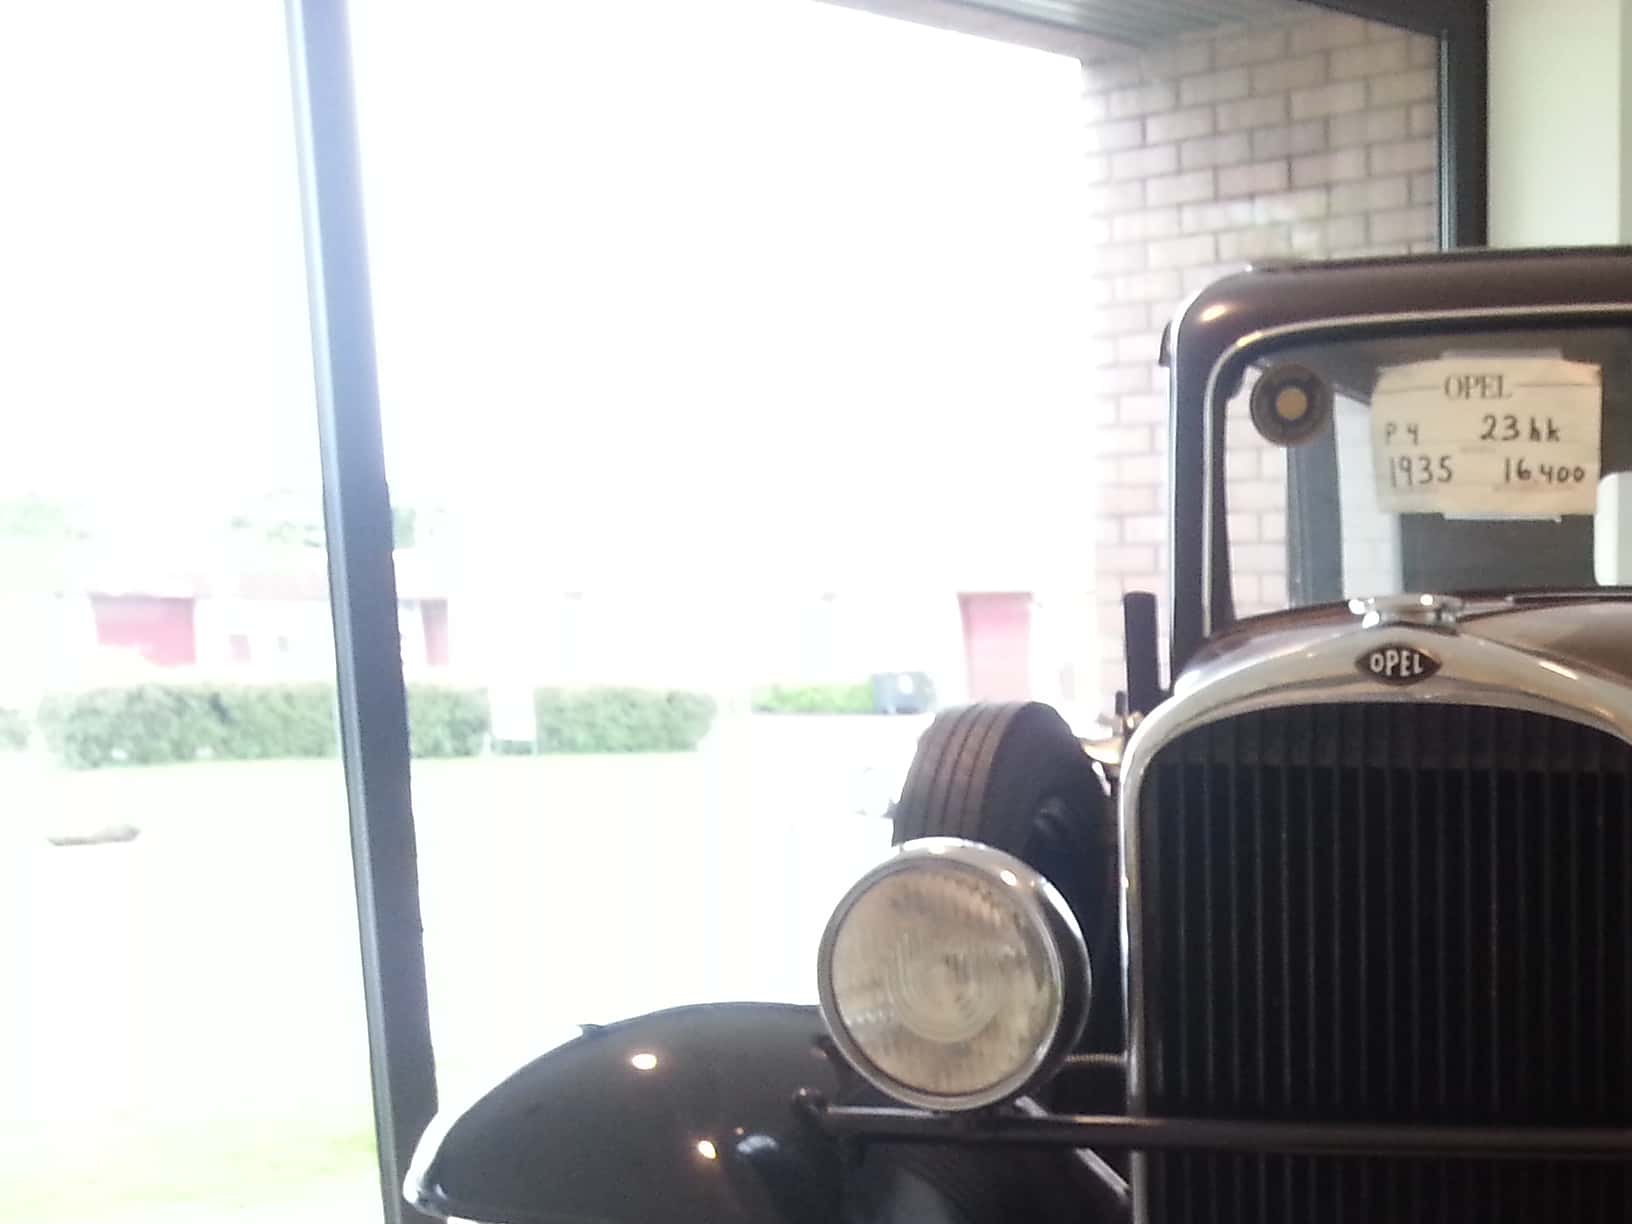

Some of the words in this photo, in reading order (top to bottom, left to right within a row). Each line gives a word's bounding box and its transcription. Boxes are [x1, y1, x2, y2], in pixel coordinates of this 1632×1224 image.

[1443, 374, 1513, 400] OPEL
[1479, 414, 1521, 441] 23
[1389, 456, 1453, 488] 1935
[1369, 649, 1424, 677] OPEL
